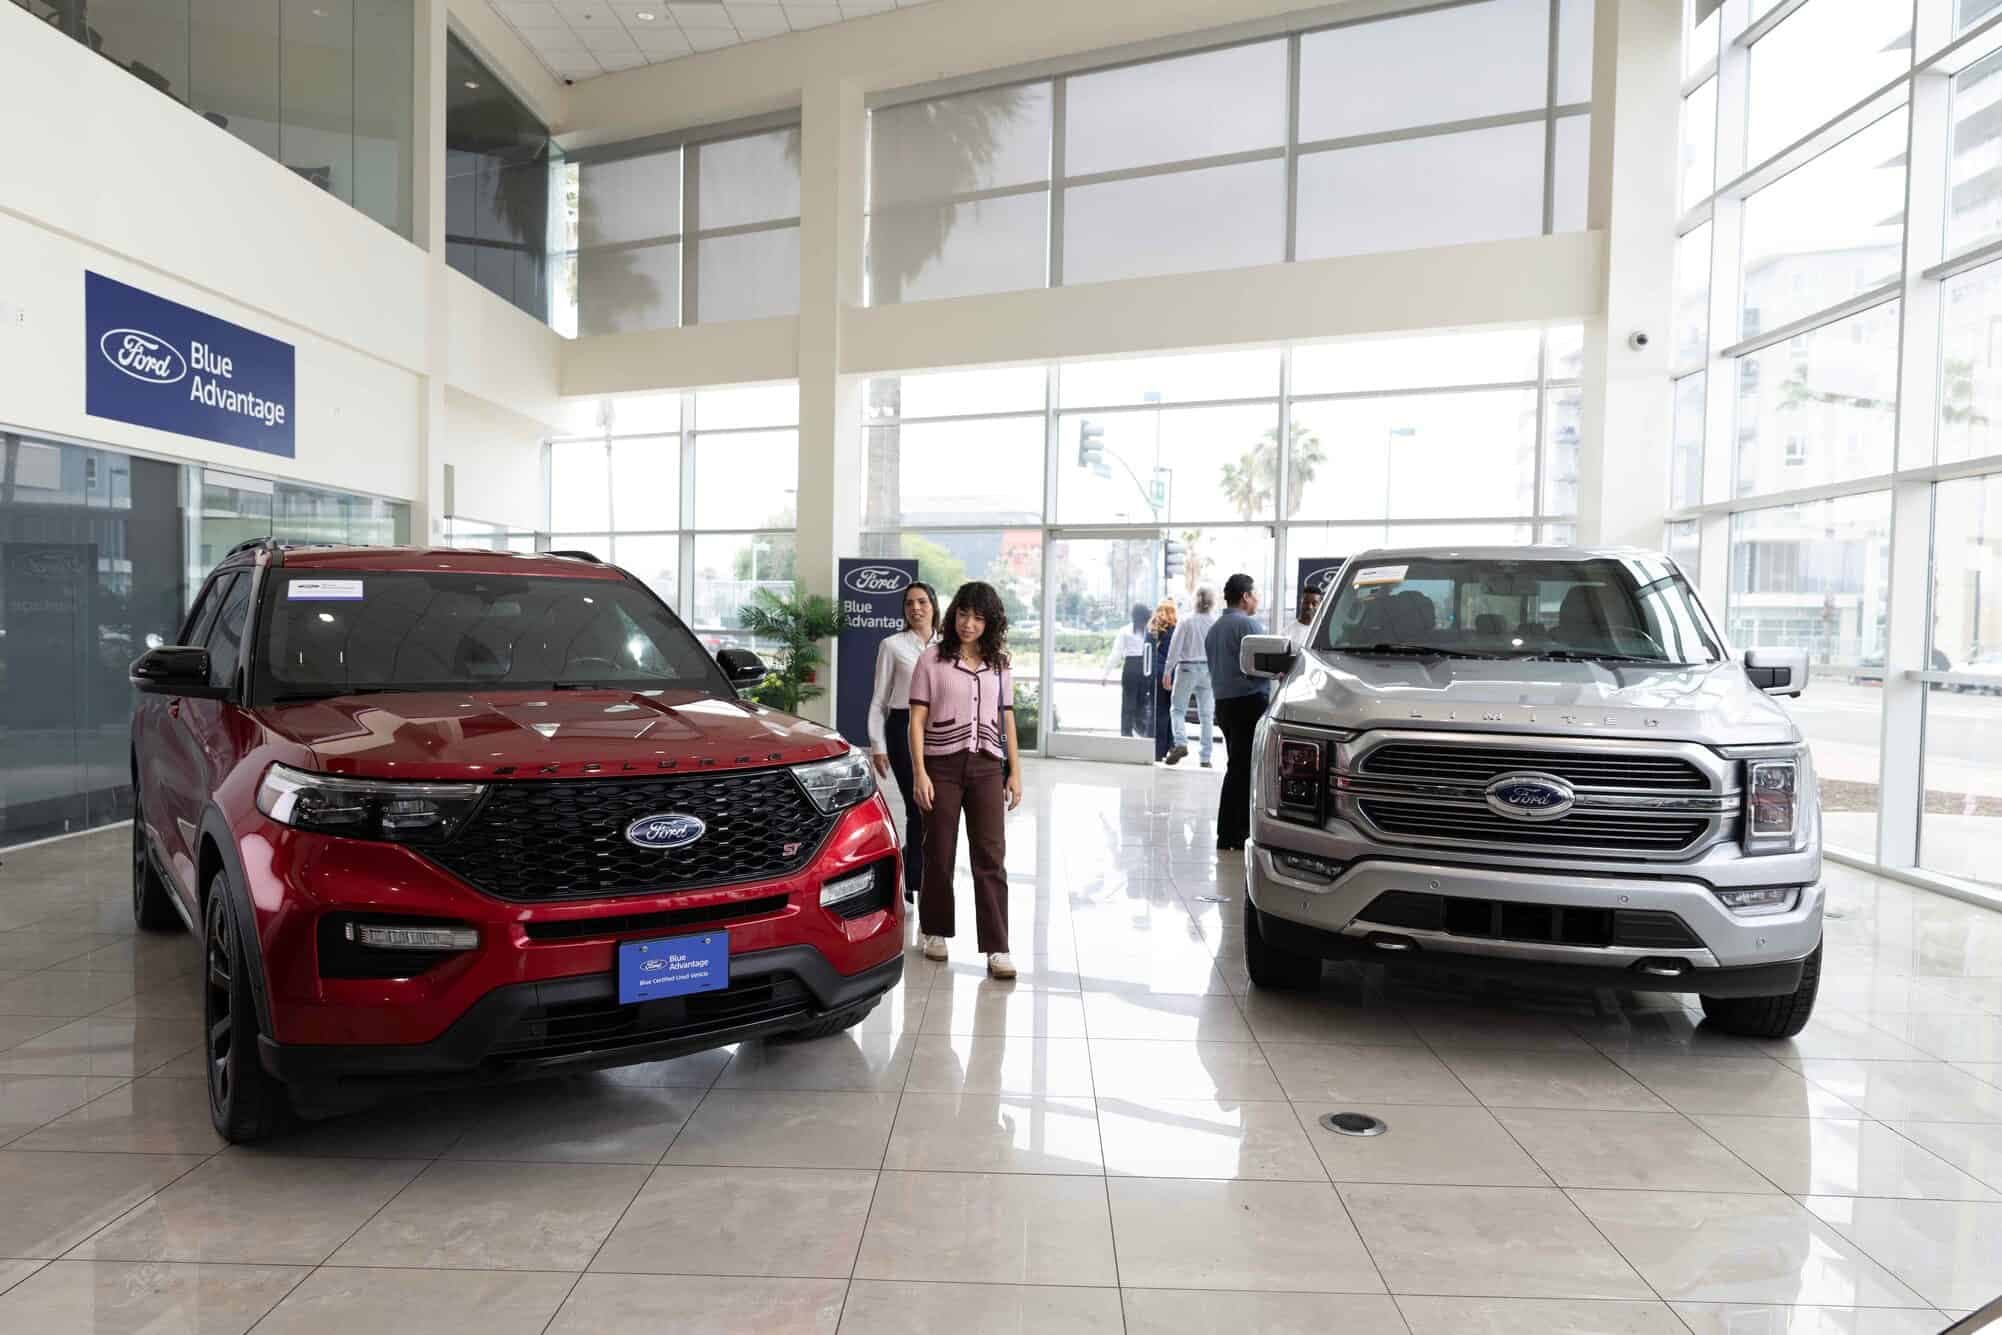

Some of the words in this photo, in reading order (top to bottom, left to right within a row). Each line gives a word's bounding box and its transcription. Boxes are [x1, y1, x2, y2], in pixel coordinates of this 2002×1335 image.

[118, 334, 172, 377] Ford
[190, 340, 233, 378] Blue
[190, 375, 285, 426] Advantage
[856, 569, 900, 589] Ford
[844, 600, 873, 613] Blue
[846, 614, 905, 631] dvantag
[1508, 787, 1552, 805] Ford
[646, 821, 688, 840] Ford
[782, 842, 802, 857] ST
[669, 954, 687, 962] Blue
[669, 960, 709, 970] Advantage
